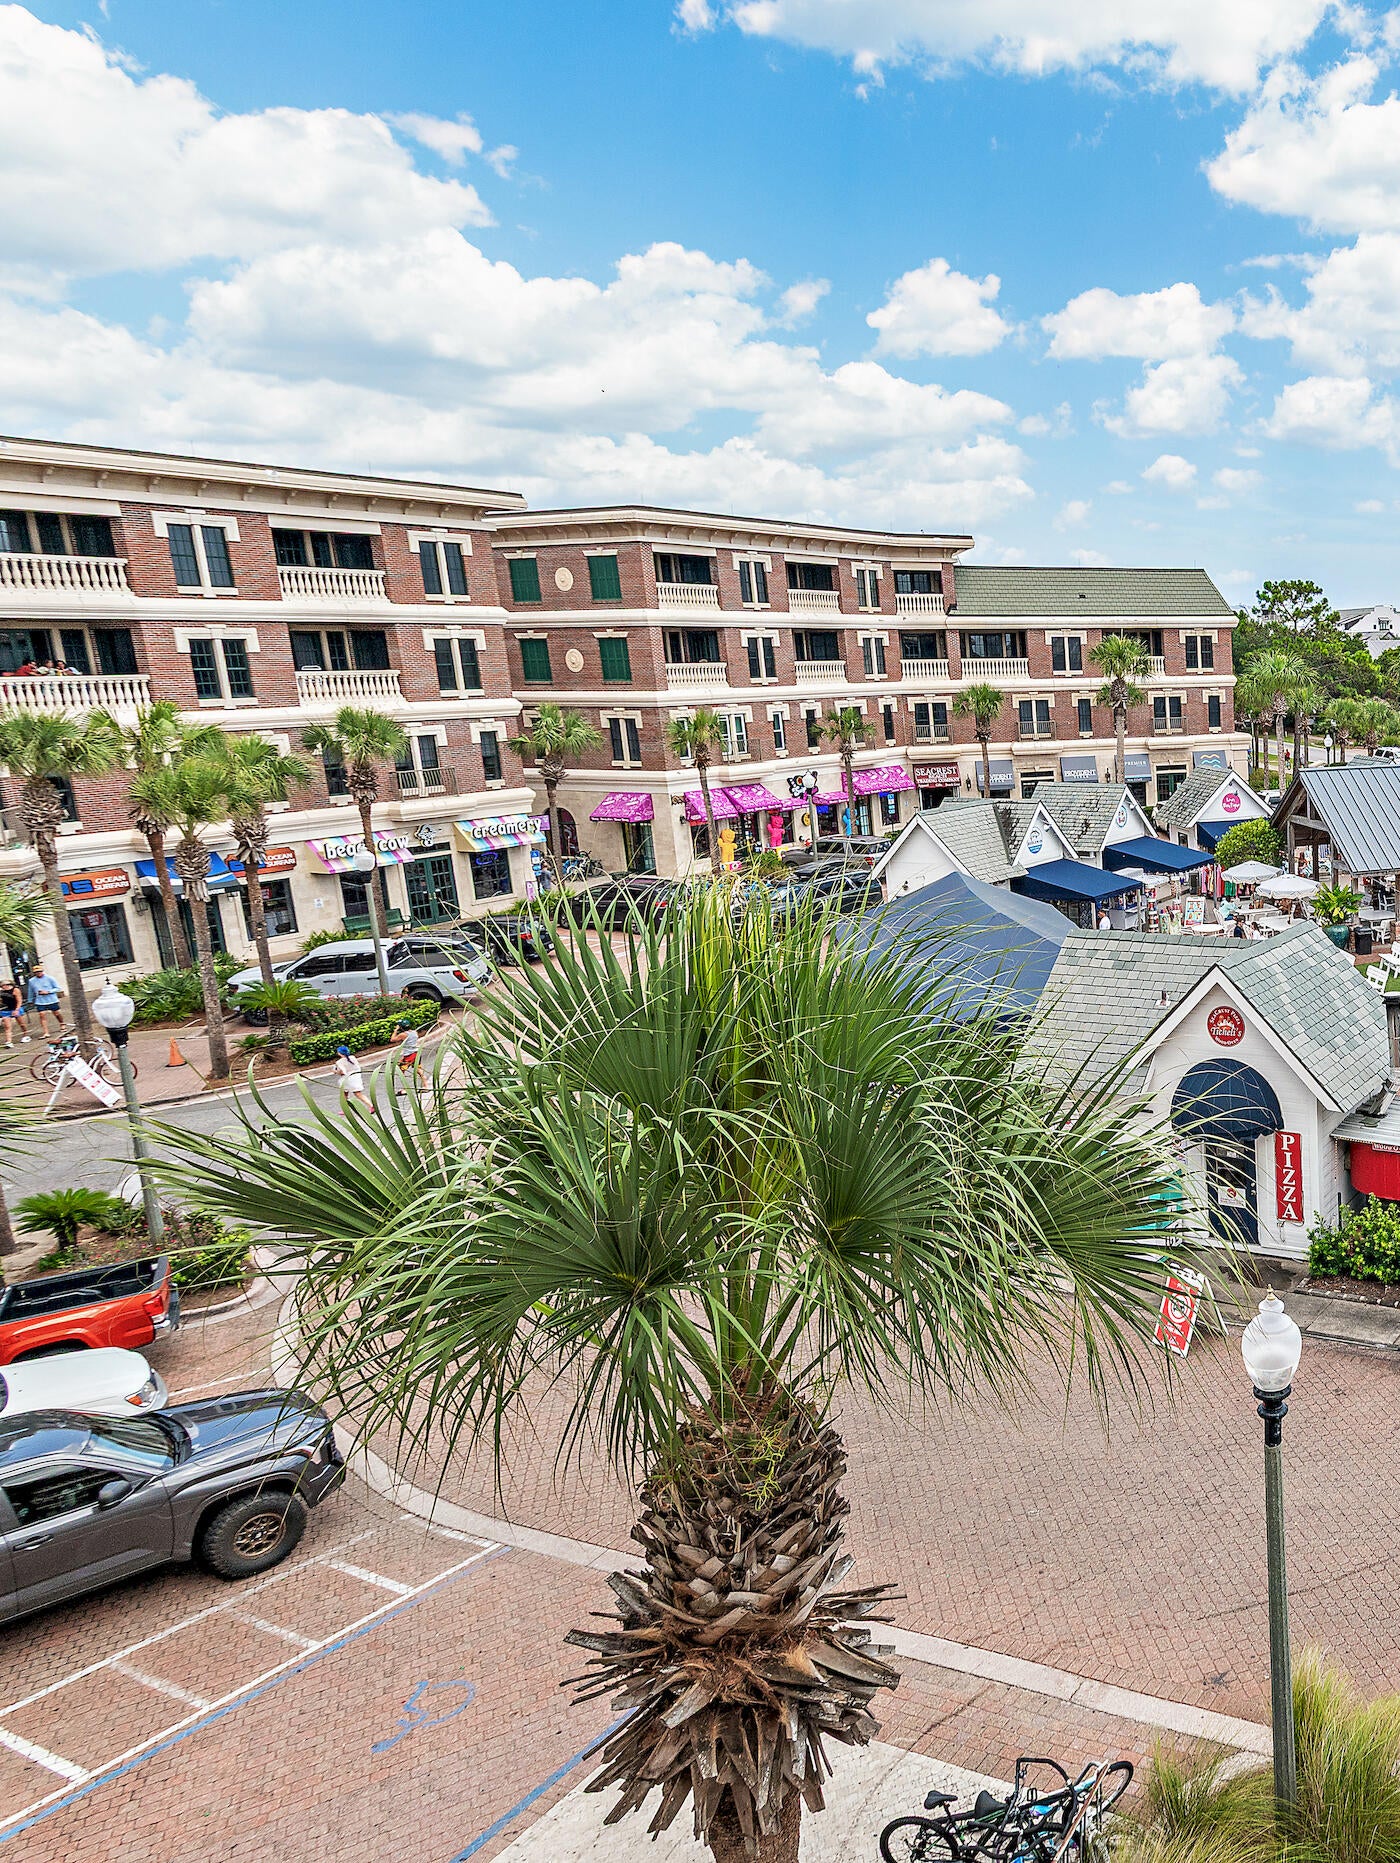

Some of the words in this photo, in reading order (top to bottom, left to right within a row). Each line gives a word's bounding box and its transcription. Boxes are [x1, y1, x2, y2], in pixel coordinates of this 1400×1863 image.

[915, 766, 957, 776] SEACREST
[1064, 769, 1096, 777] PROVIDENT
[978, 773, 1013, 781] PVIDENT
[471, 817, 542, 839] creamery
[378, 835, 410, 852] cow
[265, 853, 293, 861] OCEAN
[266, 859, 296, 868] SURFARI
[95, 875, 127, 885] OCEAN
[93, 880, 130, 892] SURFARI
[1280, 1133, 1299, 1220] PIZZA
